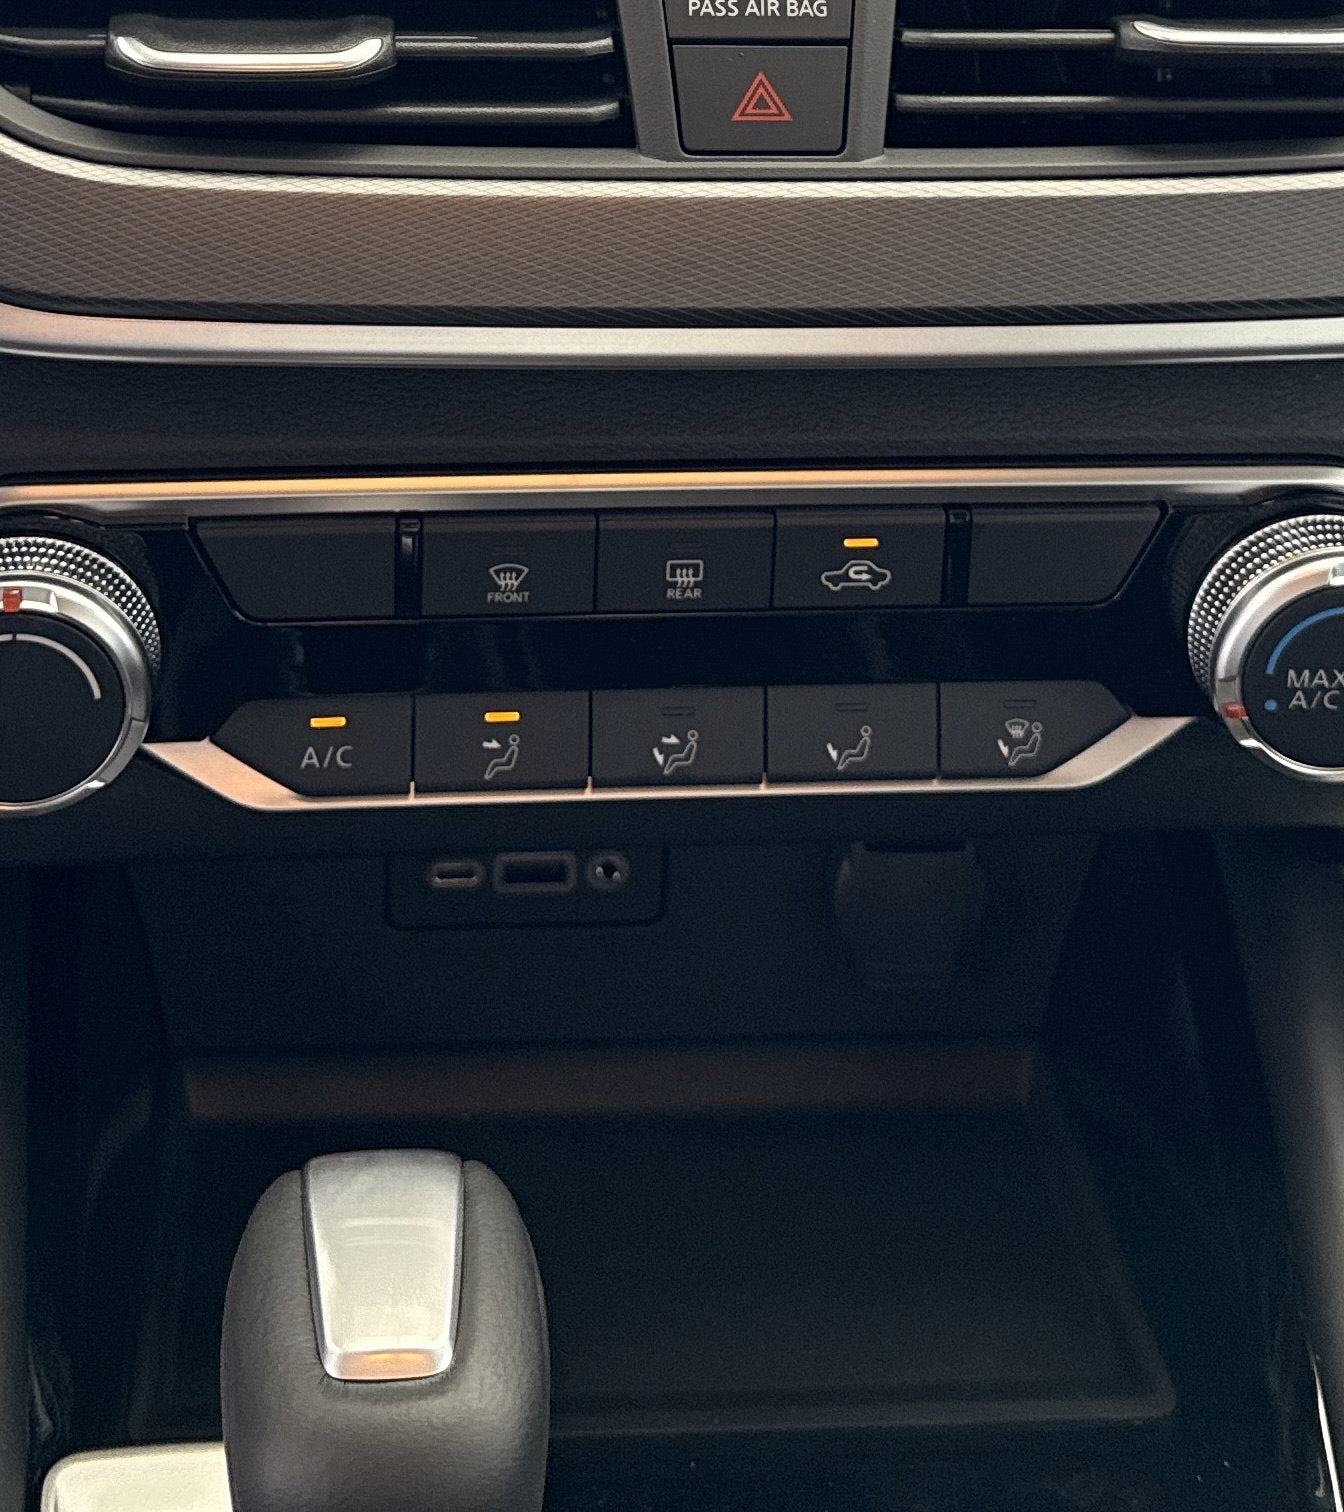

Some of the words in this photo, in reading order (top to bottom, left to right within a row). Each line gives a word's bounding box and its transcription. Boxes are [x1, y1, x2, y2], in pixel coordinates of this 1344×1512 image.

[688, 0, 738, 16] PASS
[744, 0, 780, 16] AIR
[787, 0, 827, 17] BAG
[487, 591, 531, 604] FRONT
[666, 586, 702, 600] REAR
[1288, 690, 1341, 710] A/C
[300, 745, 353, 770] A/C
